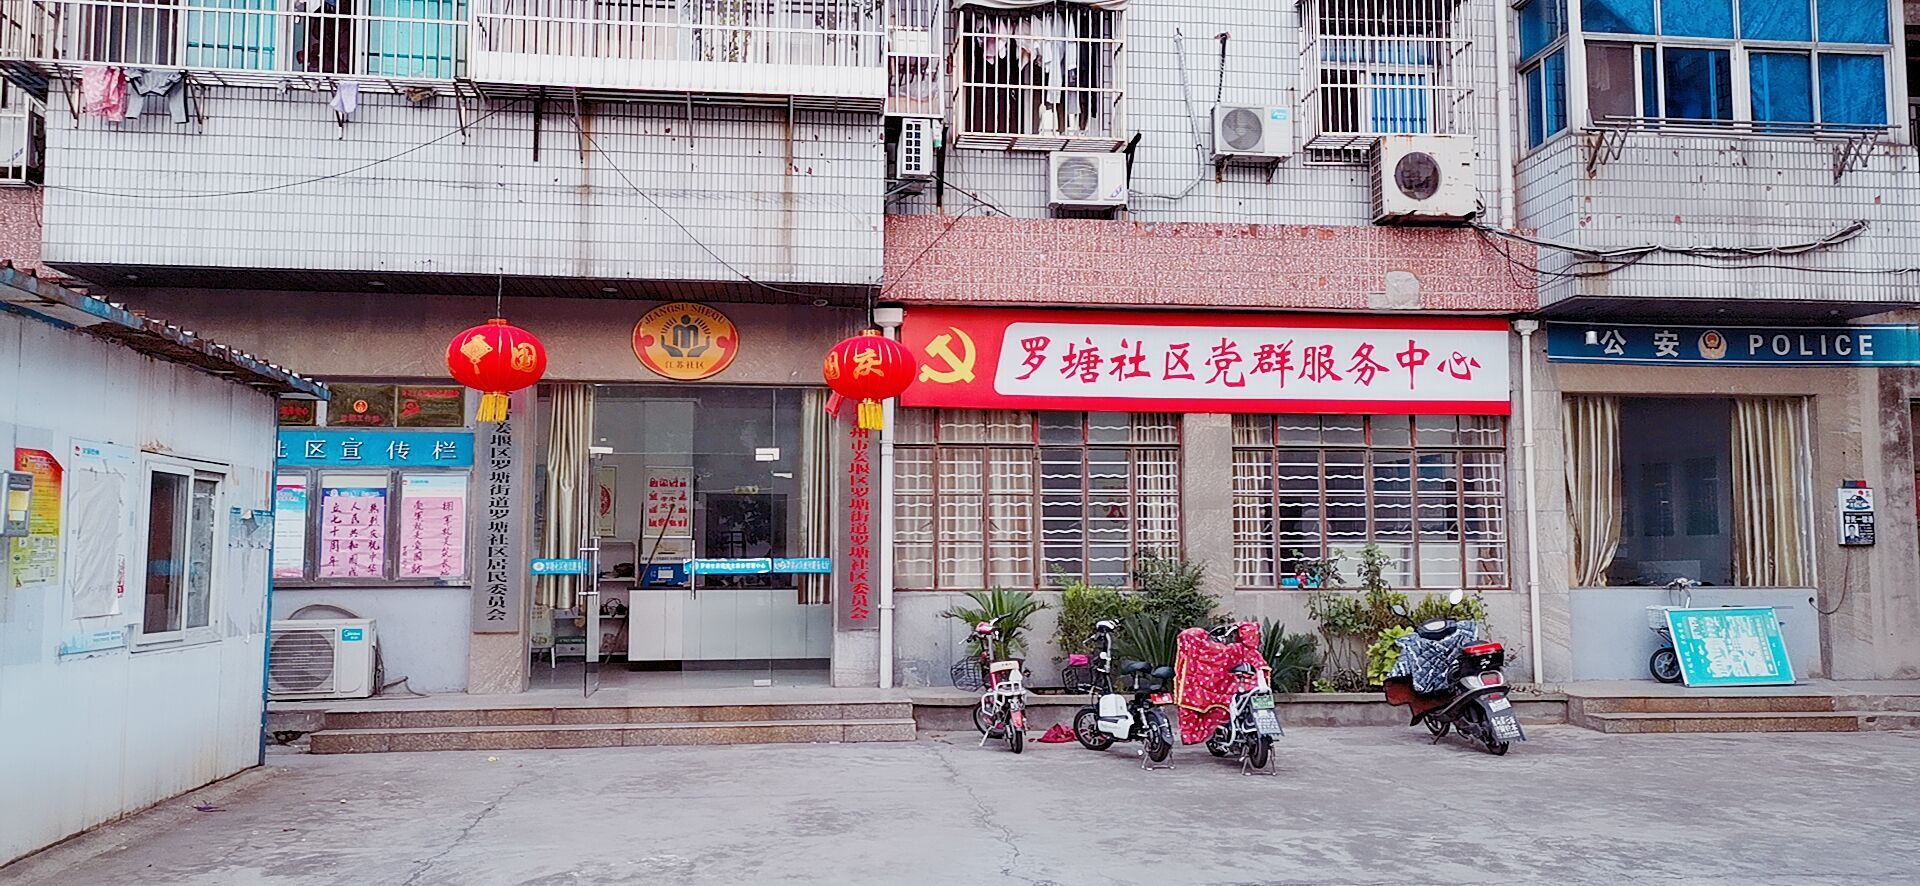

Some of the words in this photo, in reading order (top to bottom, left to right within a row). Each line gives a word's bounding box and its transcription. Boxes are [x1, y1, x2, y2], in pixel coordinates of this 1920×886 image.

[644, 303, 689, 325] JIANGSU
[690, 304, 727, 324] SHEQU
[1013, 335, 1482, 390] 罗塘社区党群服务中心
[1600, 329, 1680, 357] 公安
[1749, 334, 1874, 356] POLICE
[664, 360, 705, 369] 江苏社区
[485, 393, 512, 621] 姜堰区罗塘街道罗塘社区居民委员会
[848, 416, 871, 620] 州市姜堰区罗塘街道罗塘社区委员会
